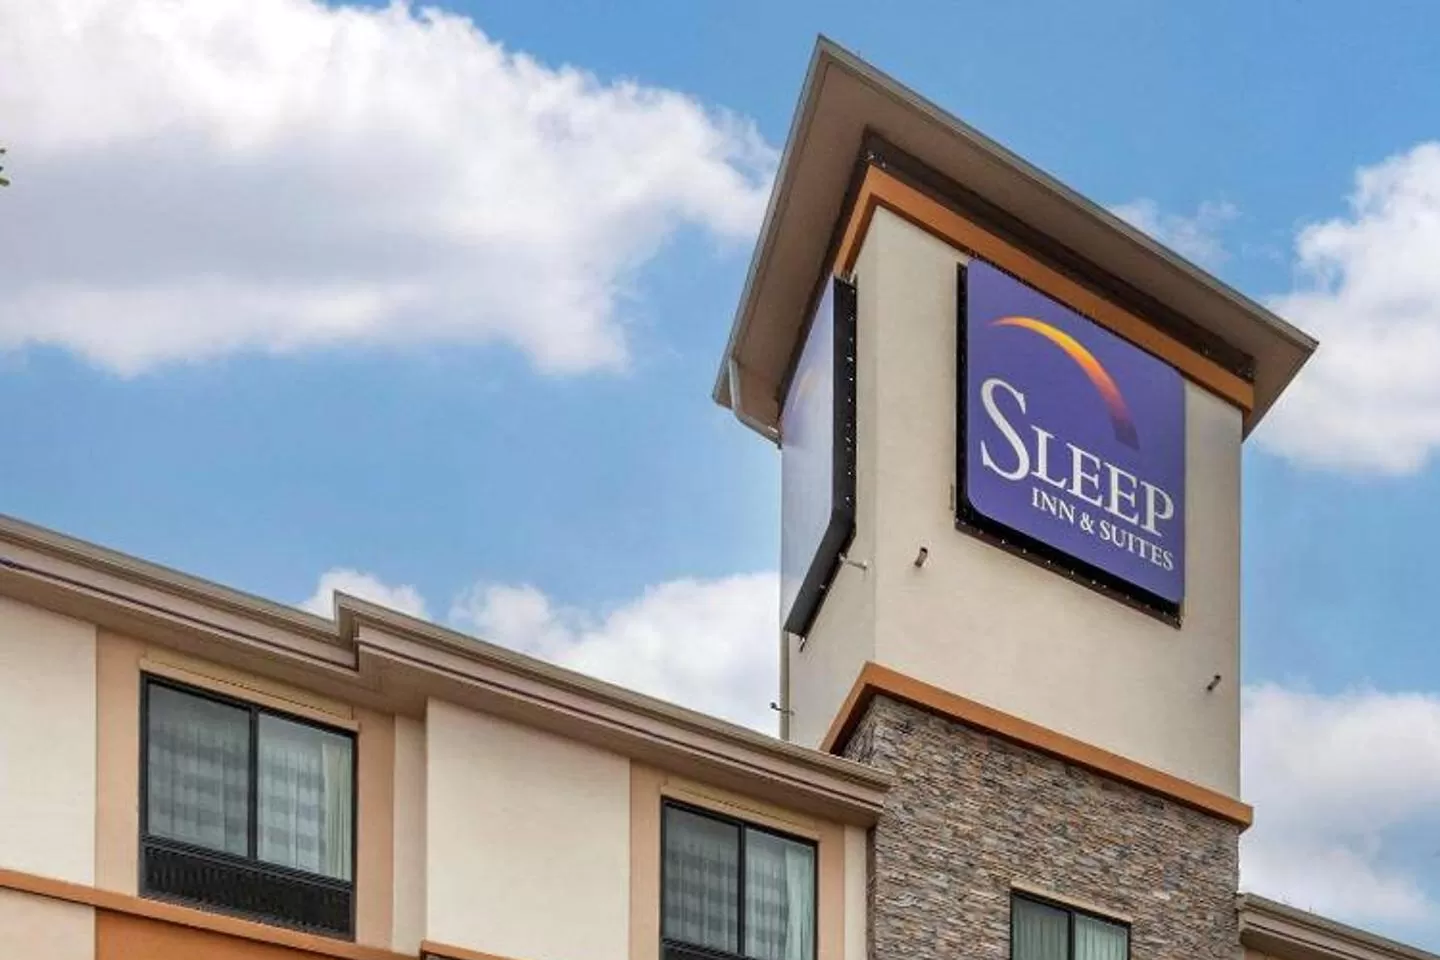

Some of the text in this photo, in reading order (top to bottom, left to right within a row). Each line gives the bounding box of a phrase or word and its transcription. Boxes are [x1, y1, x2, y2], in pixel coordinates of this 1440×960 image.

[981, 378, 1174, 536] SLEEP
[1032, 487, 1173, 571] INN & SUITES
